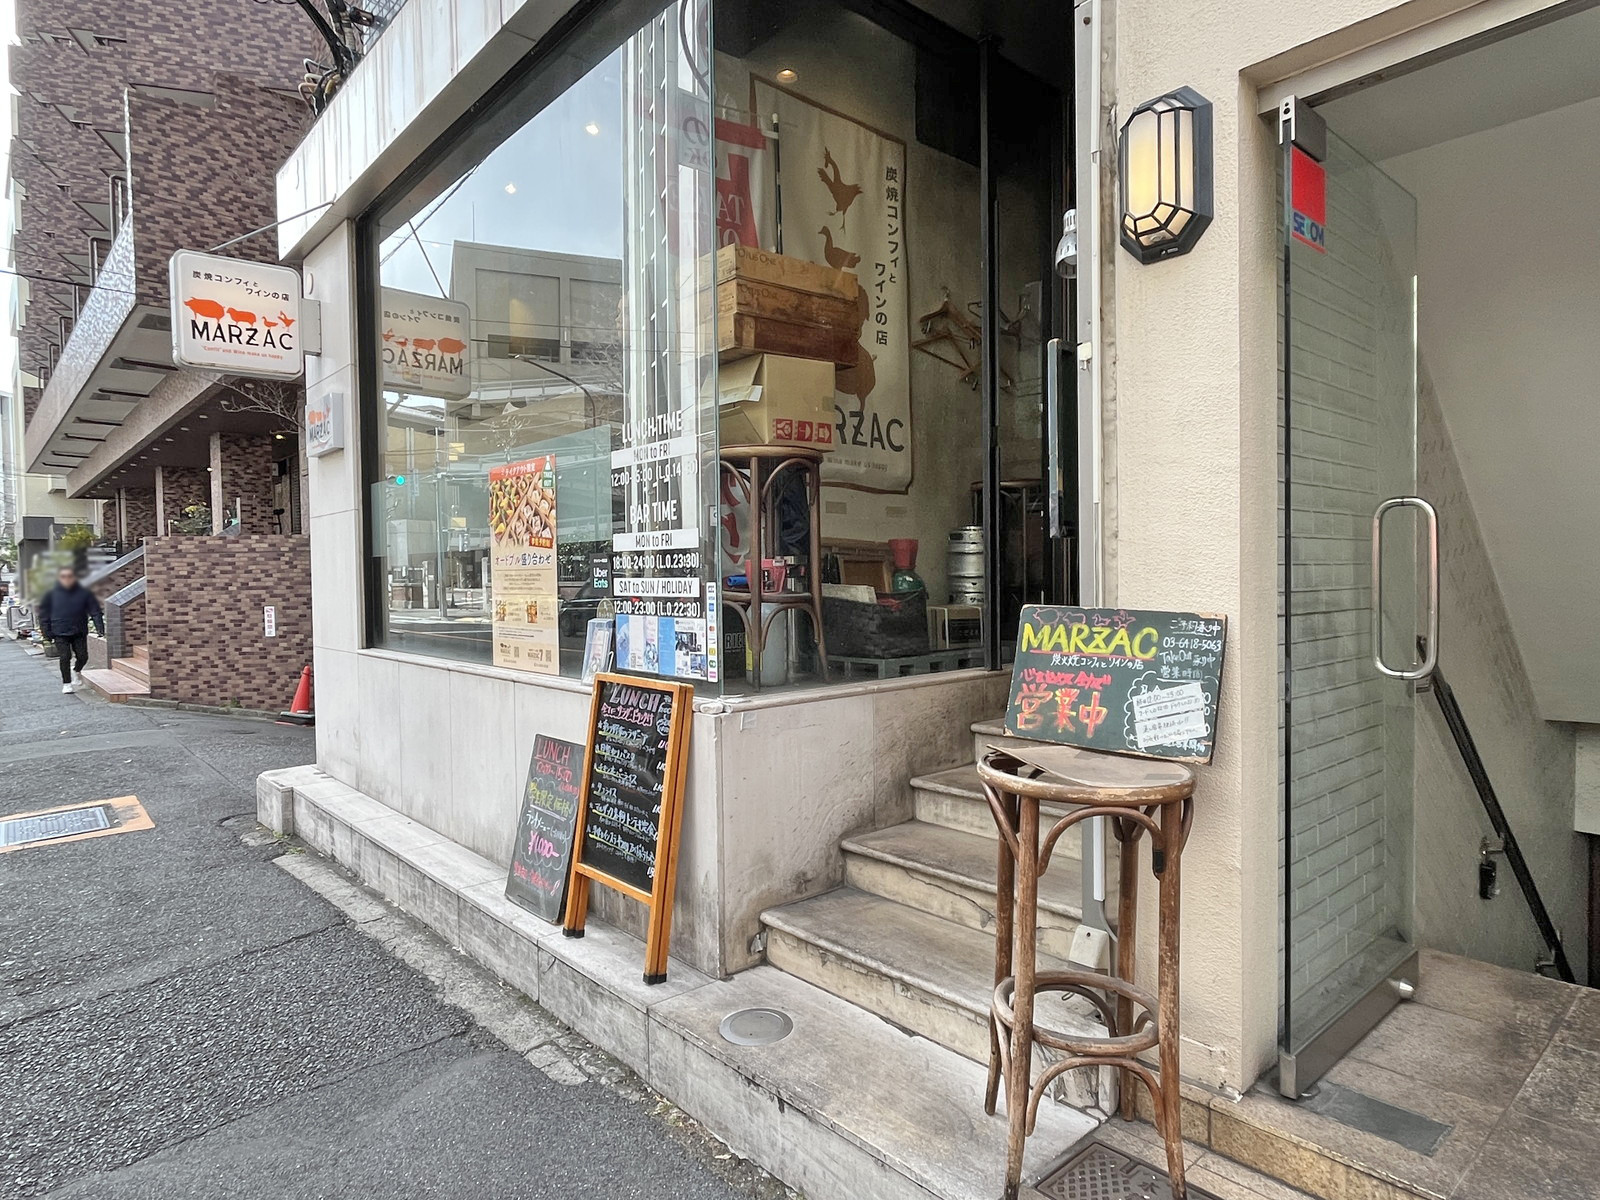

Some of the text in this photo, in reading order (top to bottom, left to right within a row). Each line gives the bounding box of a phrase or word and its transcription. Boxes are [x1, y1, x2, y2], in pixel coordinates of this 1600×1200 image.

[885, 166, 899, 284] 炭焼コンフィと
[192, 270, 259, 288] 炭焼コンフィと
[245, 288, 290, 302] ワインの店
[874, 262, 889, 346] ワインの店
[191, 319, 293, 351] MARZAC
[622, 409, 683, 444] LUNCH TIME
[650, 447, 658, 459] to
[629, 499, 678, 525] BAR TIME
[635, 532, 673, 548] MON to FRI
[593, 567, 608, 577] Uber
[594, 578, 608, 588] Eats
[619, 581, 632, 594] SAT
[633, 582, 640, 594] to
[641, 580, 655, 594] SUN
[661, 580, 693, 595] HOLIDAY
[613, 601, 656, 615] 12:00-23:00
[1021, 622, 1160, 659] MARZAC
[1163, 637, 1222, 652] 03-6418-5063
[1160, 665, 1203, 680] 営業時間
[610, 685, 661, 713] LUNCH
[1014, 682, 1108, 738] 営業中
[536, 738, 571, 766] LUNCH
